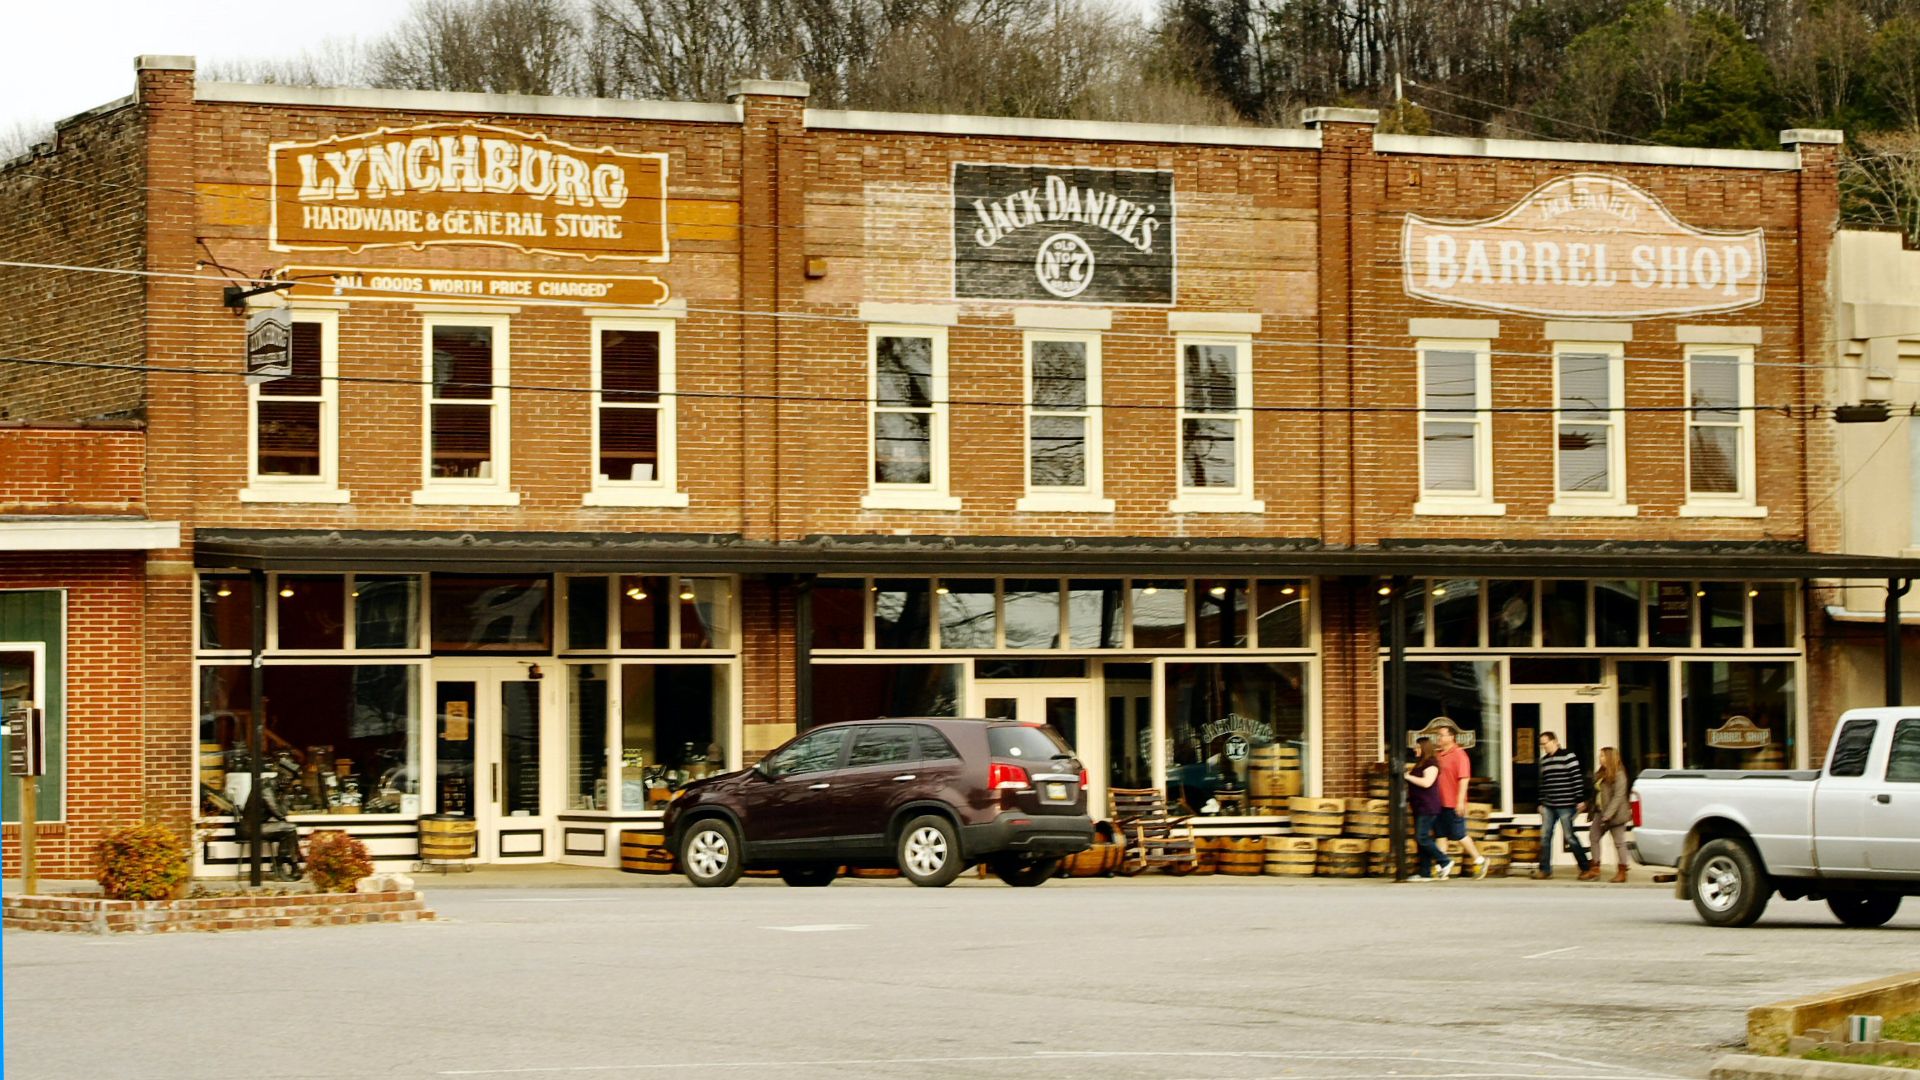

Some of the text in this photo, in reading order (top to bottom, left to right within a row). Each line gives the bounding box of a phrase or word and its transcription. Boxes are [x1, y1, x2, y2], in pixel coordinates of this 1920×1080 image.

[297, 135, 629, 209] LYNCHBURG
[303, 206, 623, 239] HARDWARE & GENERAL STORE
[973, 175, 1161, 252] JACK DANIEL'S
[1539, 193, 1574, 222] JACK
[1053, 240, 1077, 251] OLD
[1423, 234, 1754, 296] BARREL SHOP
[371, 276, 423, 292] GOODS
[428, 278, 484, 294] WORTH
[489, 279, 533, 296] PRICE
